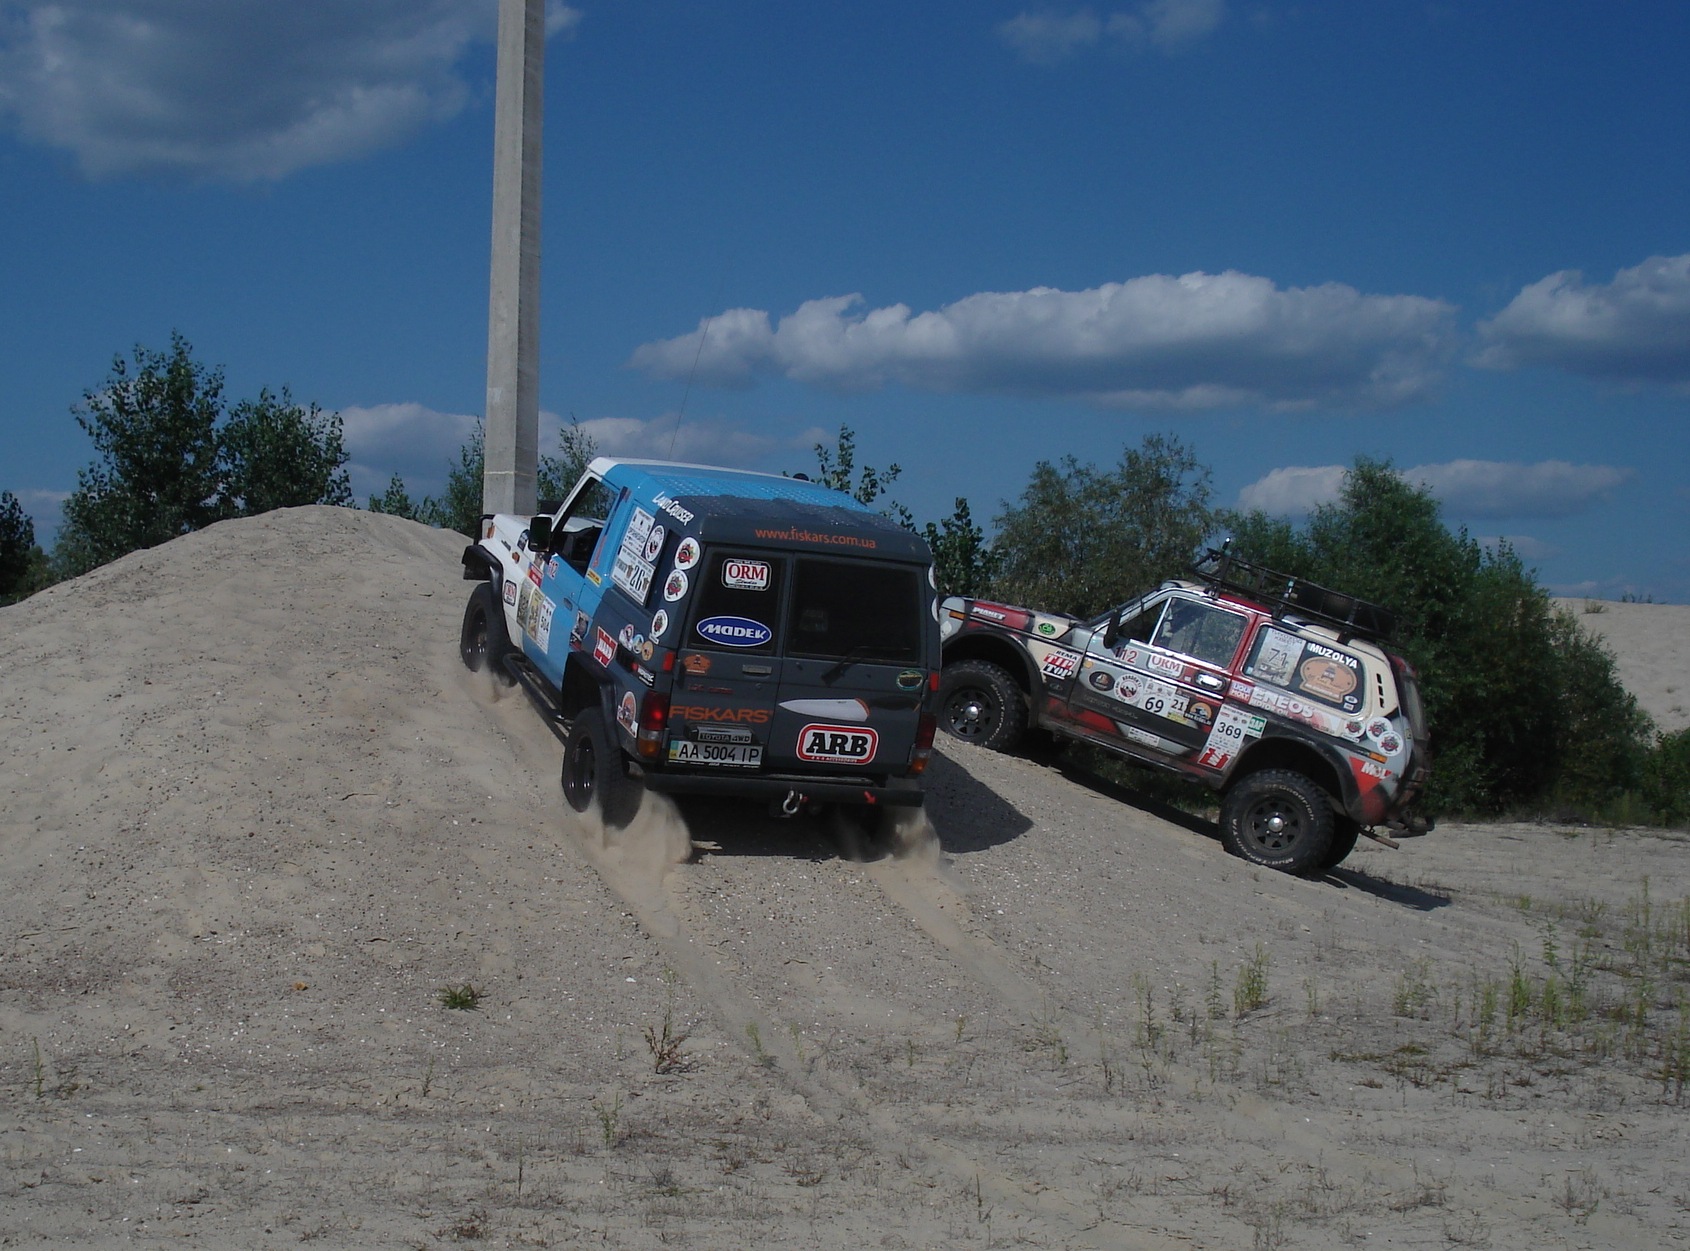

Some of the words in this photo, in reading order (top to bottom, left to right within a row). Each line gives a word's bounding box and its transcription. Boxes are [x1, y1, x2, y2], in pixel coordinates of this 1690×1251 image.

[755, 527, 877, 549] www.fiskars.com.ua
[728, 563, 765, 581] ORM
[972, 606, 1007, 621] PLANET
[702, 623, 767, 640] MADEK
[1046, 655, 1075, 669] TIP
[1056, 650, 1078, 661] REMA
[1309, 642, 1358, 669] MUZOLYA
[1046, 664, 1073, 678] TOP
[1145, 697, 1164, 713] 69
[1171, 699, 1184, 712] 21
[1252, 687, 1317, 719] ENEOS
[668, 705, 770, 723] FISKARS
[701, 733, 729, 741] TOYOTA
[1217, 722, 1242, 739] 369
[679, 743, 699, 759] AA
[703, 745, 737, 761] 5004
[742, 748, 759, 762] IP
[806, 731, 869, 757] ARB
